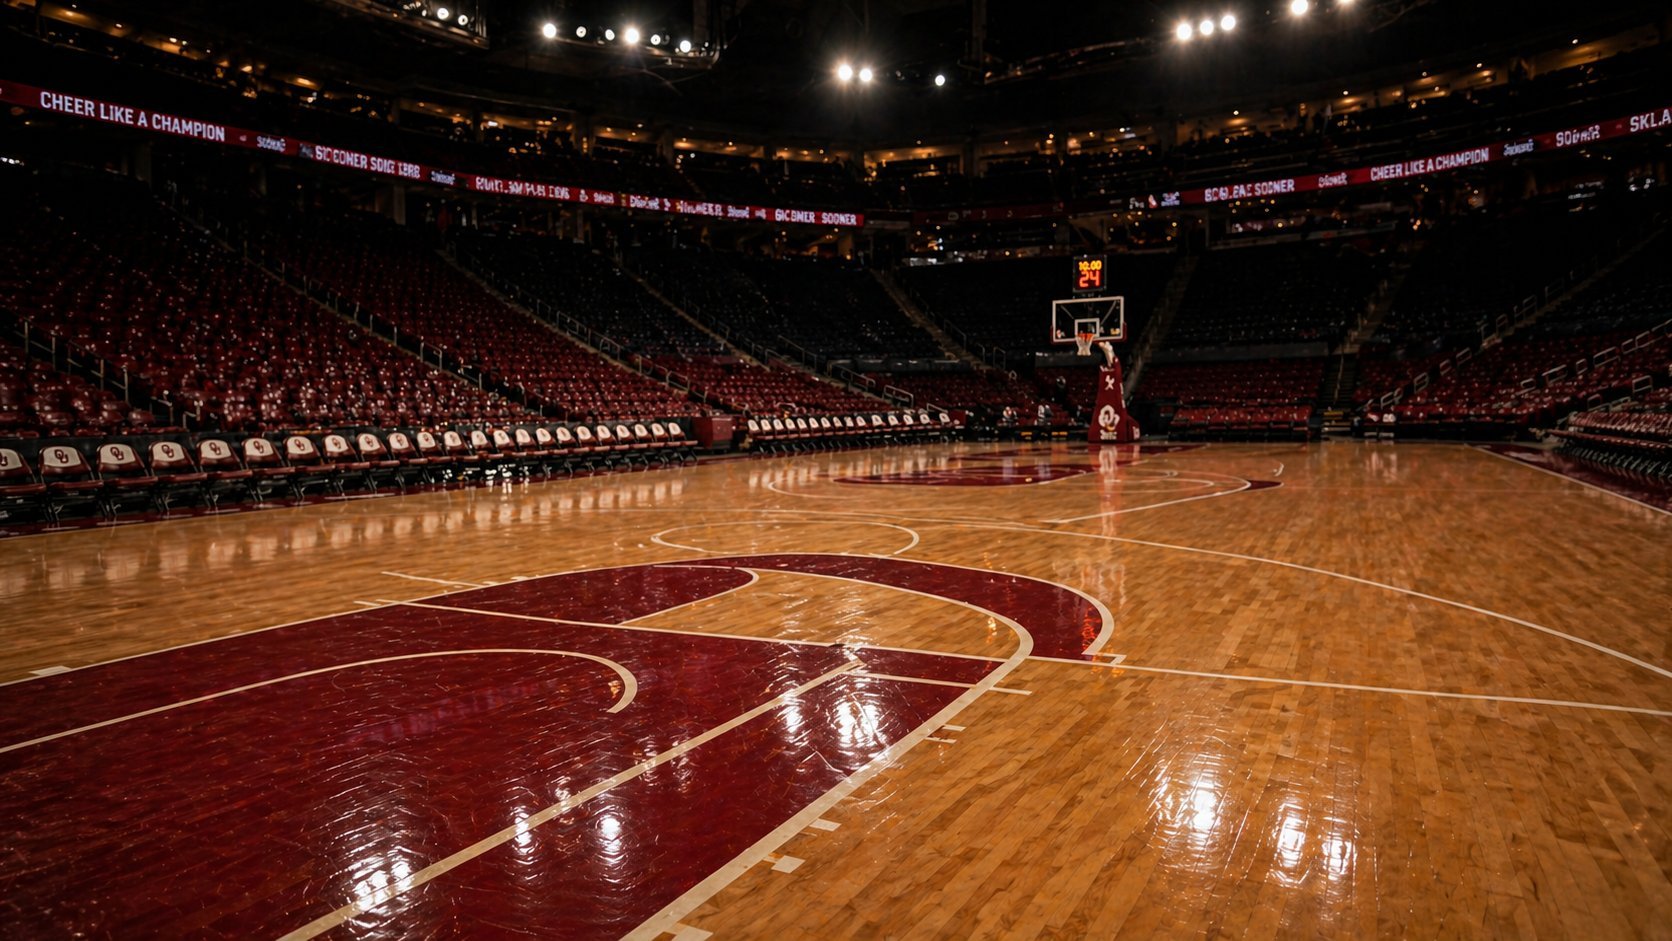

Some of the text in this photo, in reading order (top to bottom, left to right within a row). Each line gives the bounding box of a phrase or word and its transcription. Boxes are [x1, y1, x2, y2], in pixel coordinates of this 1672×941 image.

[40, 91, 225, 142] CHEER LIKE A CHAMPION
[1370, 148, 1489, 181] CHEER LIKE A CHAMPION
[1079, 270, 1100, 287] 24
